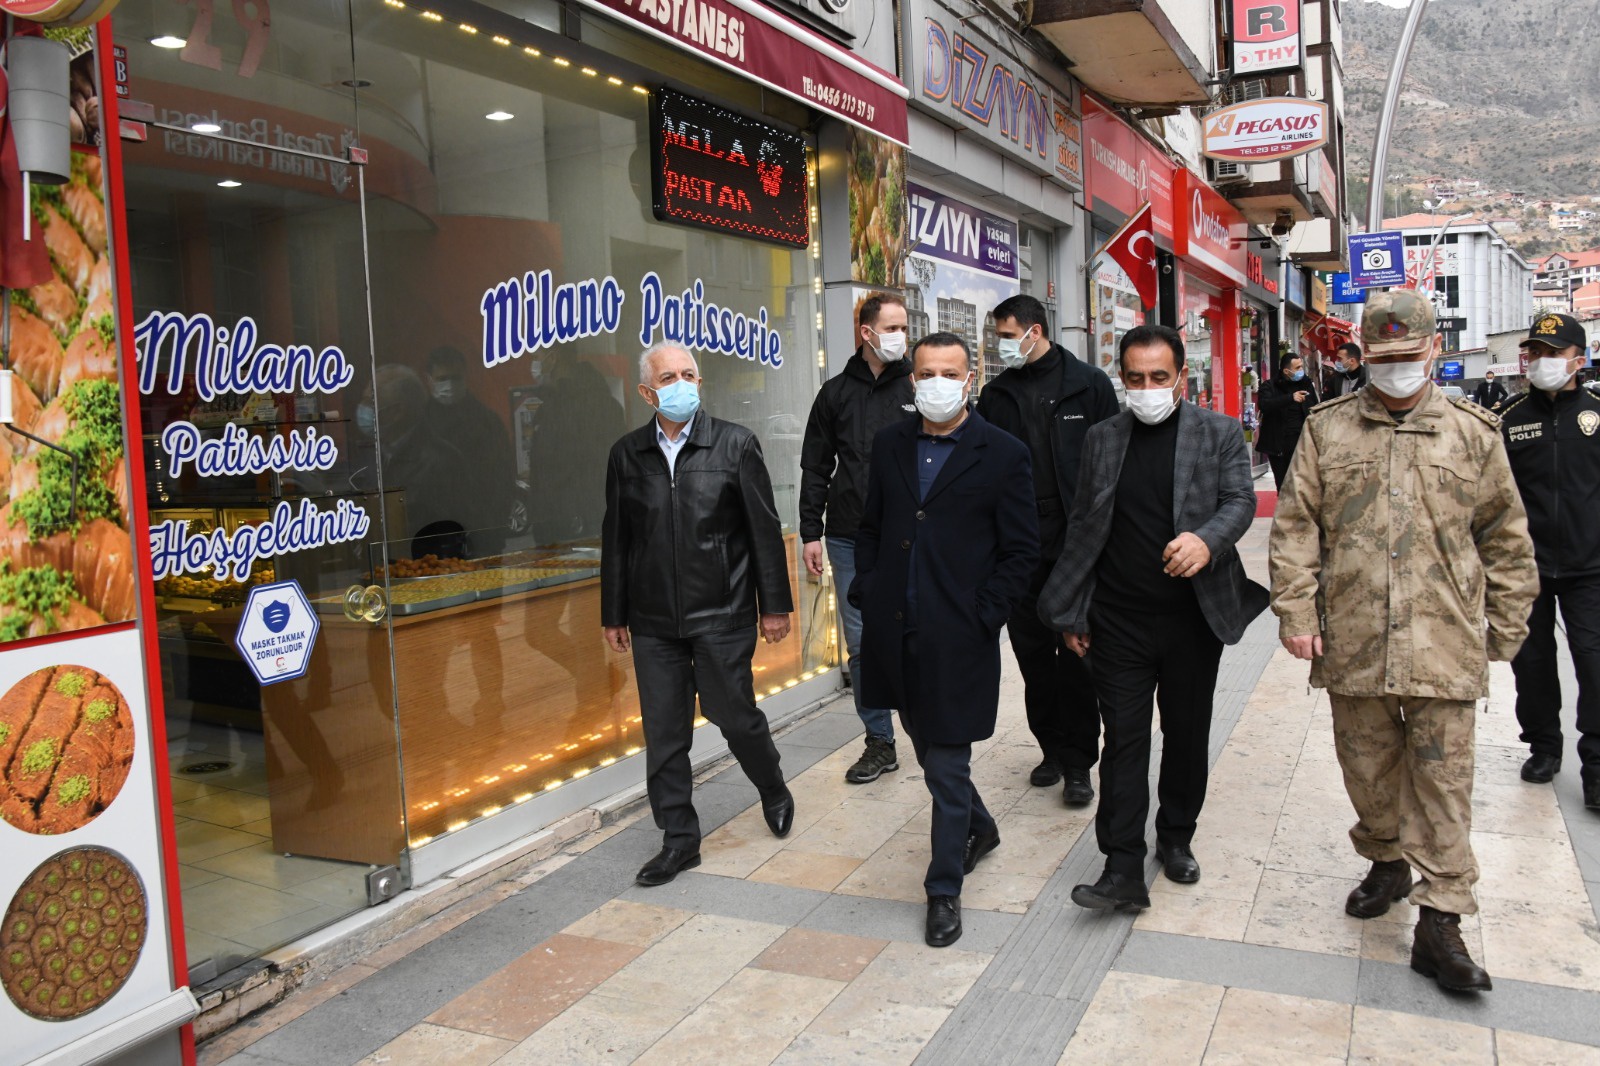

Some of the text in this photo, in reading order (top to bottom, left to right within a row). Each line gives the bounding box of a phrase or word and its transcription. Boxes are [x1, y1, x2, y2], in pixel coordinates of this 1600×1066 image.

[624, 0, 745, 62] ASTANESi
[1254, 45, 1297, 62] THY
[802, 75, 817, 98] TEL:
[817, 83, 840, 107] 0456
[840, 92, 856, 113] 213
[857, 99, 867, 118] 57
[1235, 113, 1320, 136] PEGASUS
[1281, 131, 1314, 141] AIRLINES
[666, 170, 752, 214] PASTAN
[986, 225, 1011, 247] yaşam
[1202, 211, 1229, 250] vodafone
[987, 246, 1011, 265] evleri
[1342, 288, 1361, 296] BÜFE
[480, 268, 784, 370] Milano Patisserie
[133, 311, 354, 402] Milano
[162, 421, 338, 478] Patissrie
[149, 498, 370, 583] Hoşgeldiniz
[251, 630, 306, 650] MASKE TAKMAK
[256, 642, 303, 660] ZORUNLUDUR
